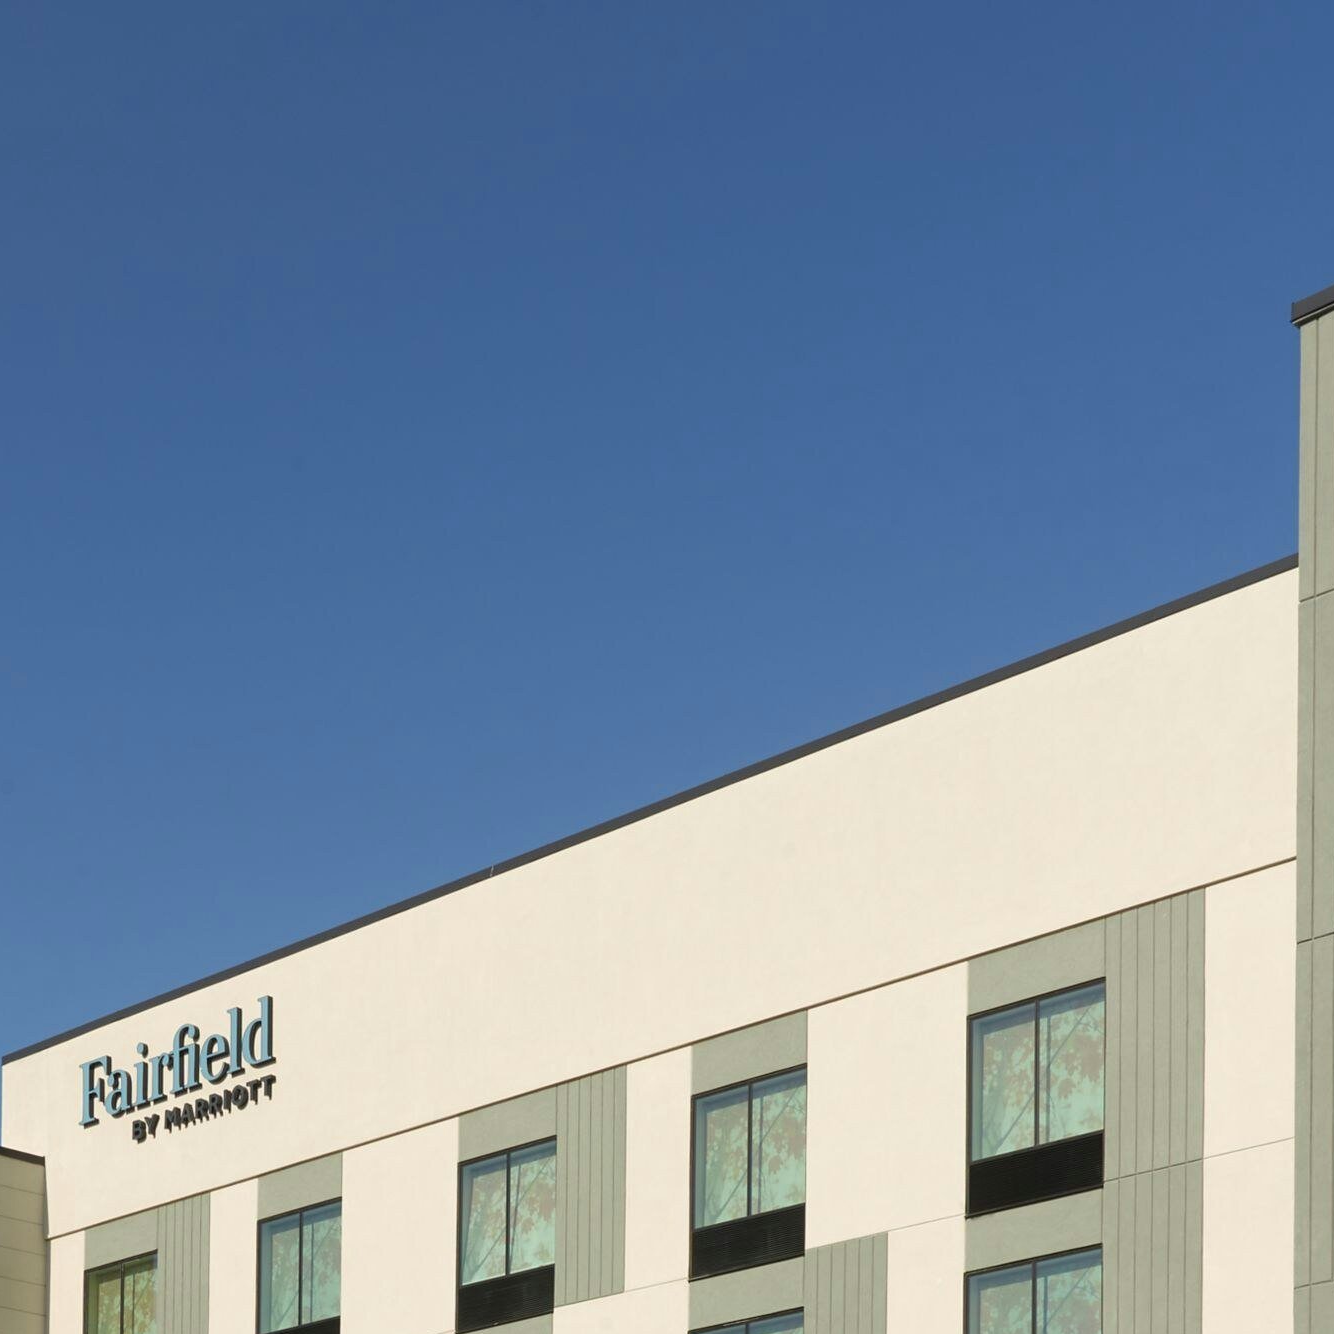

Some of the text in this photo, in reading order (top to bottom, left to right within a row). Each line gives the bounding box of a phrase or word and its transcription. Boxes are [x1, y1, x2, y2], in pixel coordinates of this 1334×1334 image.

[79, 995, 275, 1128] Fairfield
[132, 1075, 276, 1142] BY MARRIOTT
